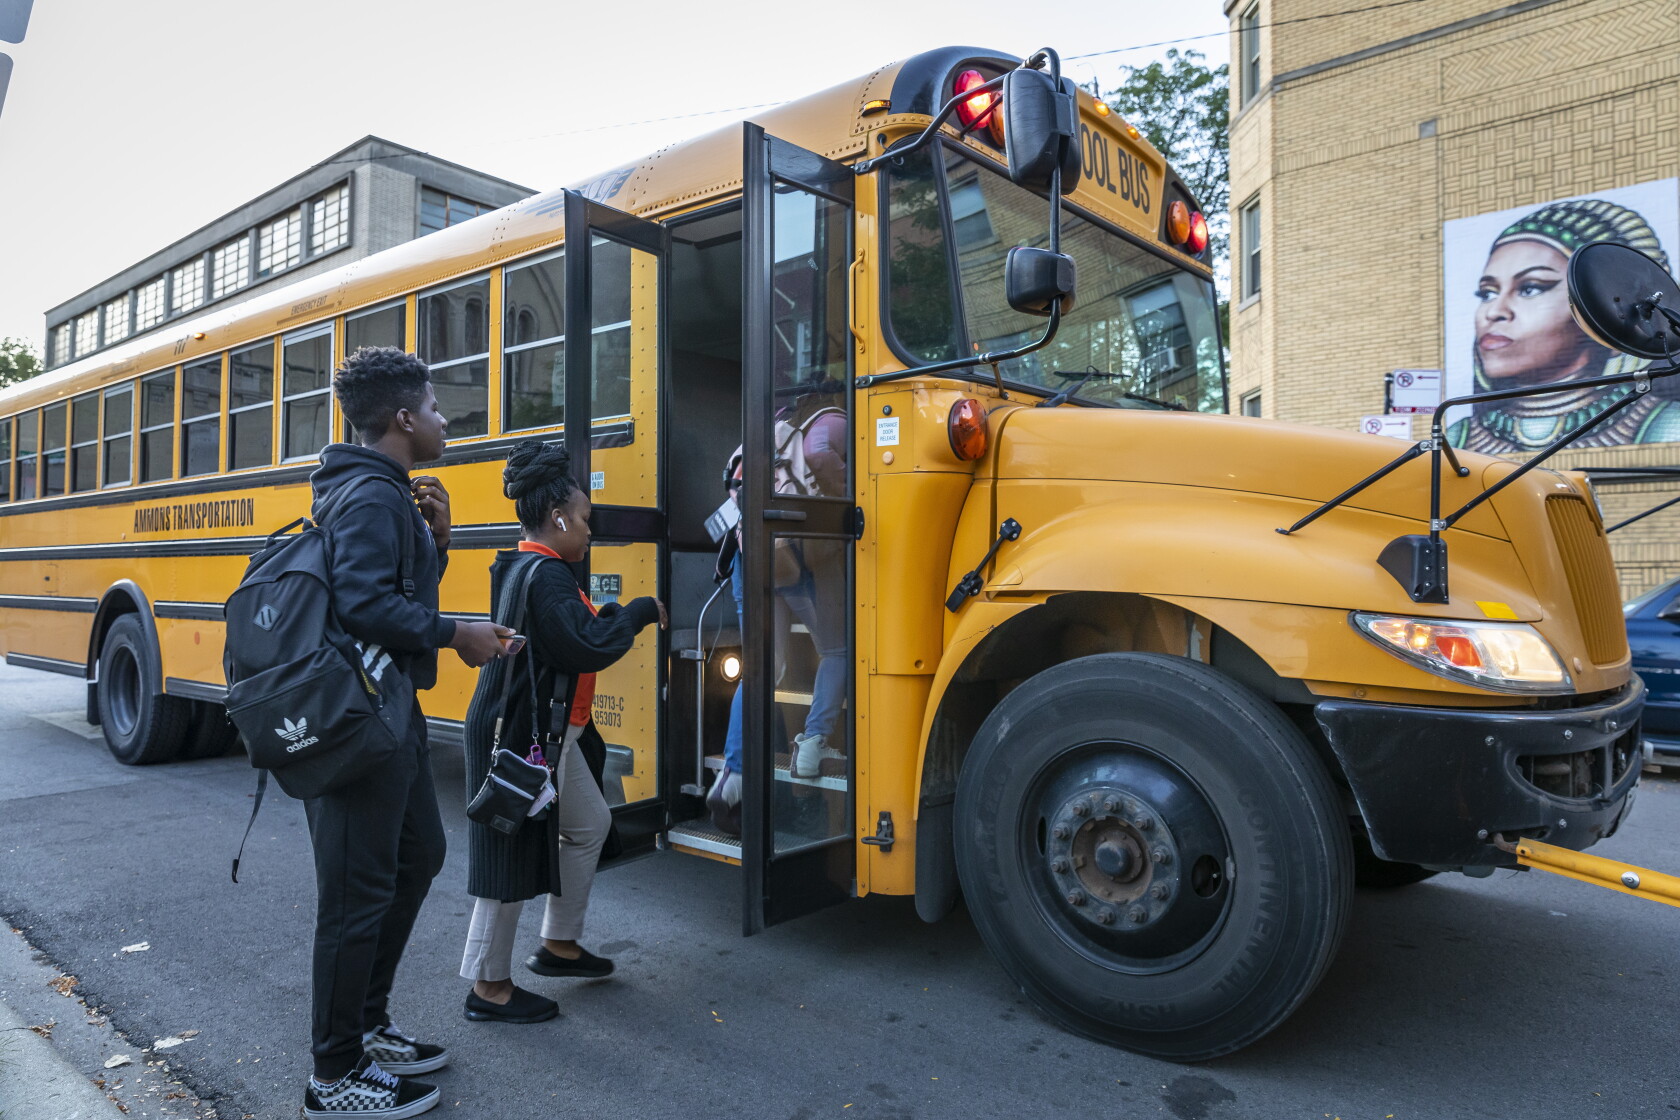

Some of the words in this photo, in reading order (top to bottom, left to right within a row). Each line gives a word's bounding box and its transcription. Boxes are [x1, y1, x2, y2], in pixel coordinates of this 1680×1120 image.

[1081, 122, 1117, 195] OOL
[1118, 147, 1150, 214] BUS
[134, 505, 171, 533] AMMONS
[173, 498, 254, 531] TRANSPORTATION
[594, 710, 622, 728] 953073
[286, 736, 319, 753] adidas
[1211, 787, 1284, 994] CONTINENTAL
